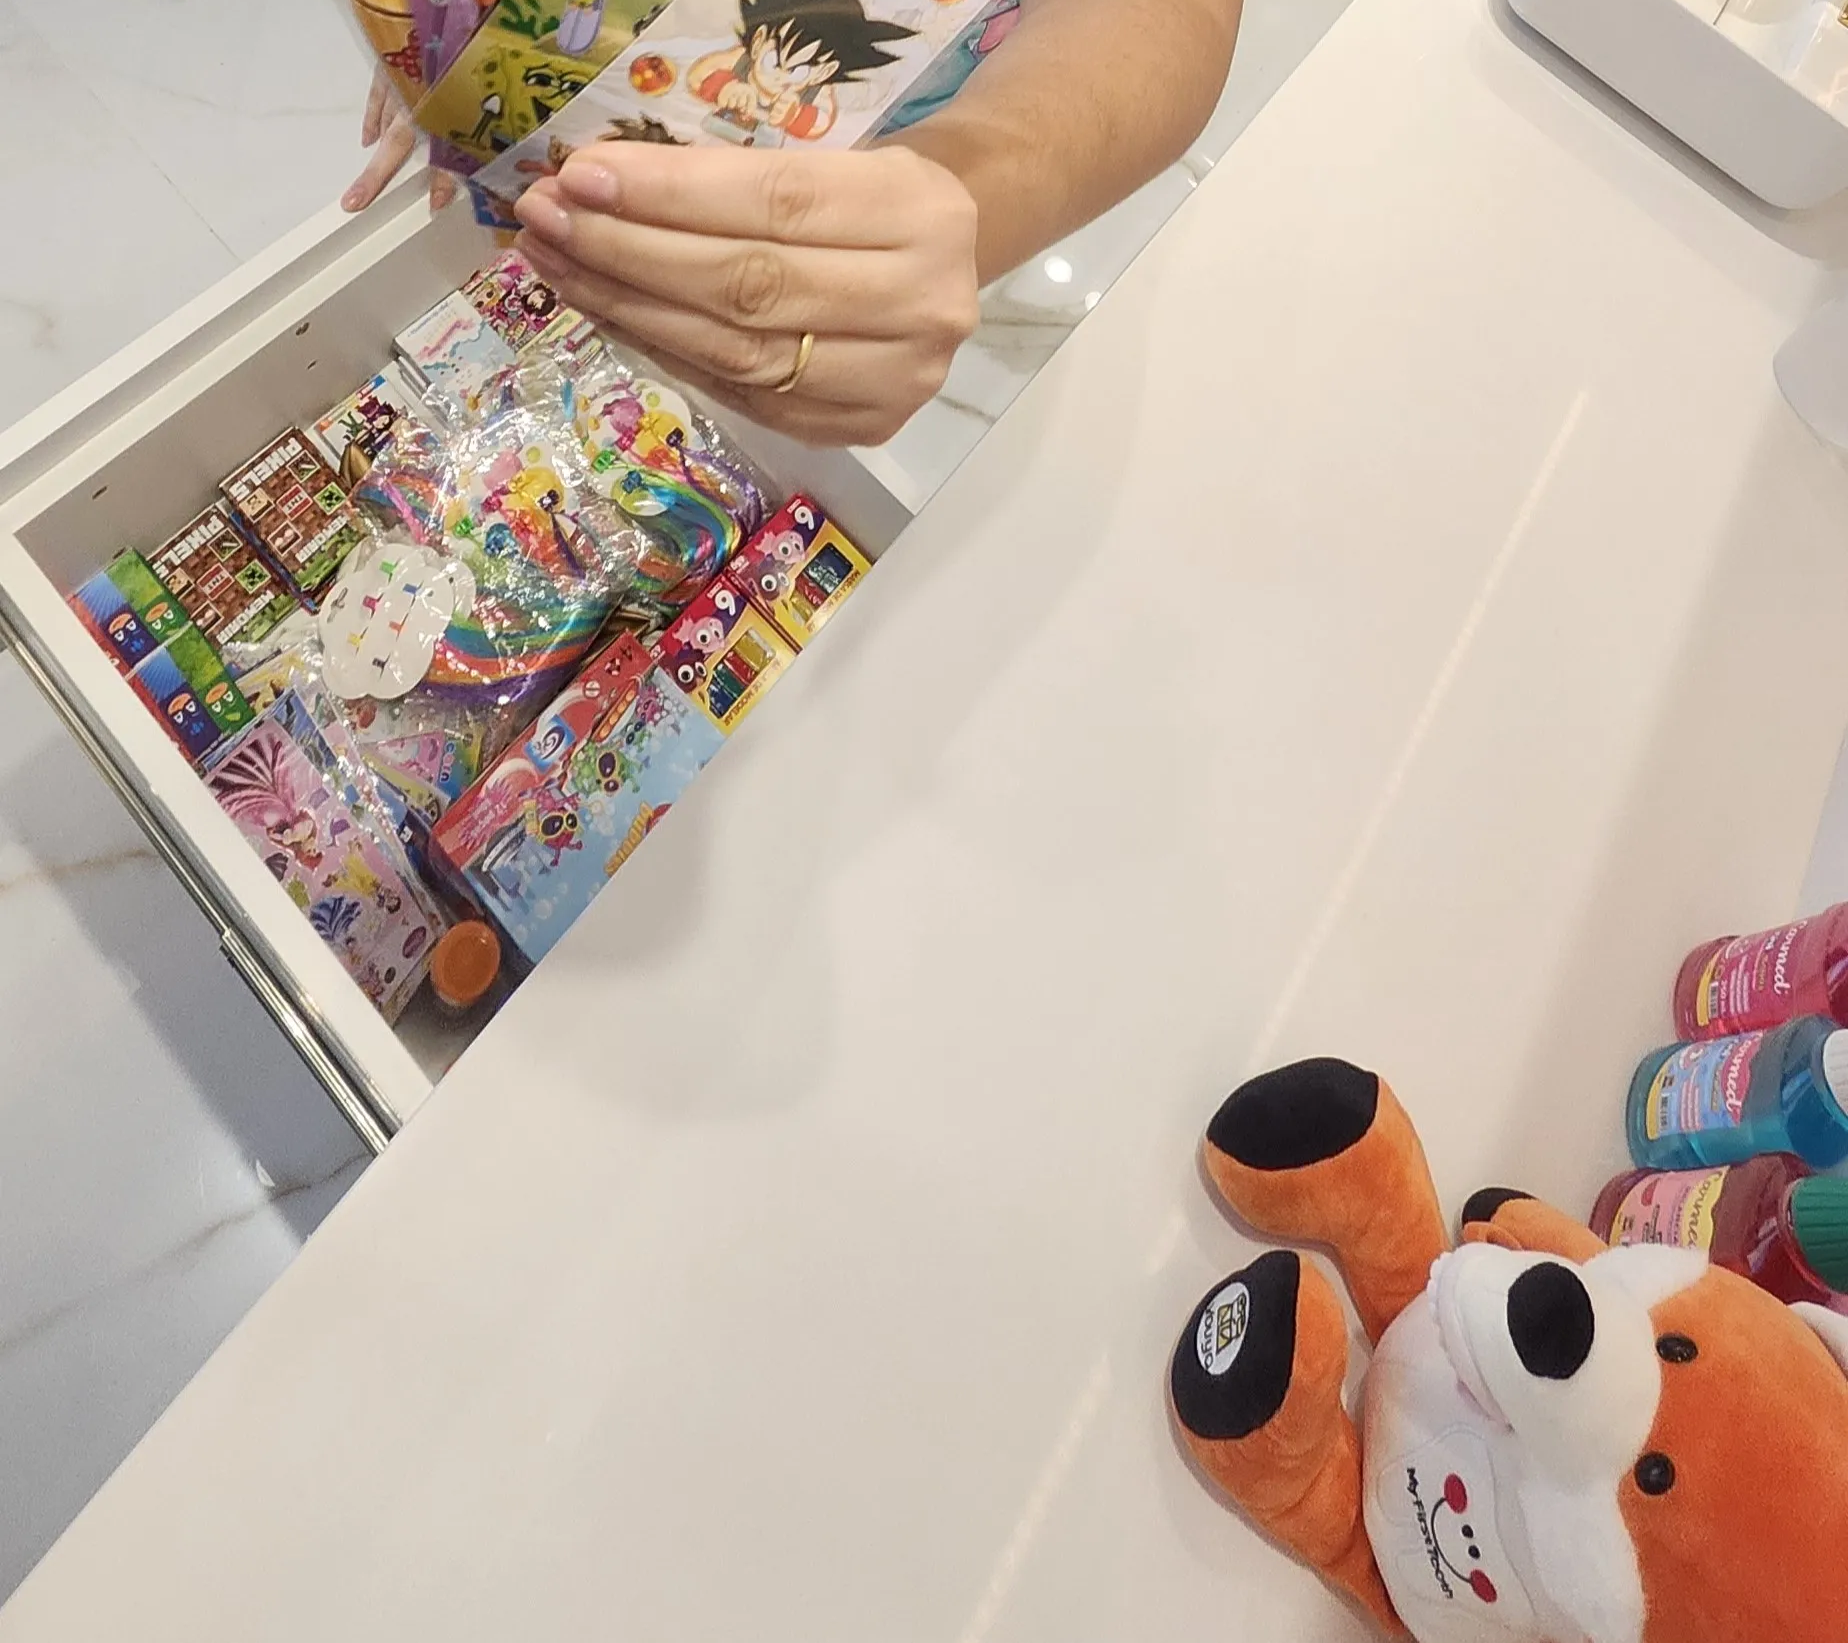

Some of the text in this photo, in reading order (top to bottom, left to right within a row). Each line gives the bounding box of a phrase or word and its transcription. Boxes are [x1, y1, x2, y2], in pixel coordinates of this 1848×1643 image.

[228, 436, 303, 502] PIXELS
[285, 492, 305, 513] TNT
[793, 506, 815, 531] 6
[151, 514, 224, 579] PIXELS
[203, 572, 225, 594] TNT
[713, 589, 736, 616] 6
[722, 690, 755, 727] MODELAR
[1774, 917, 1808, 995] Carmed
[1685, 1169, 1724, 1250] Carme
